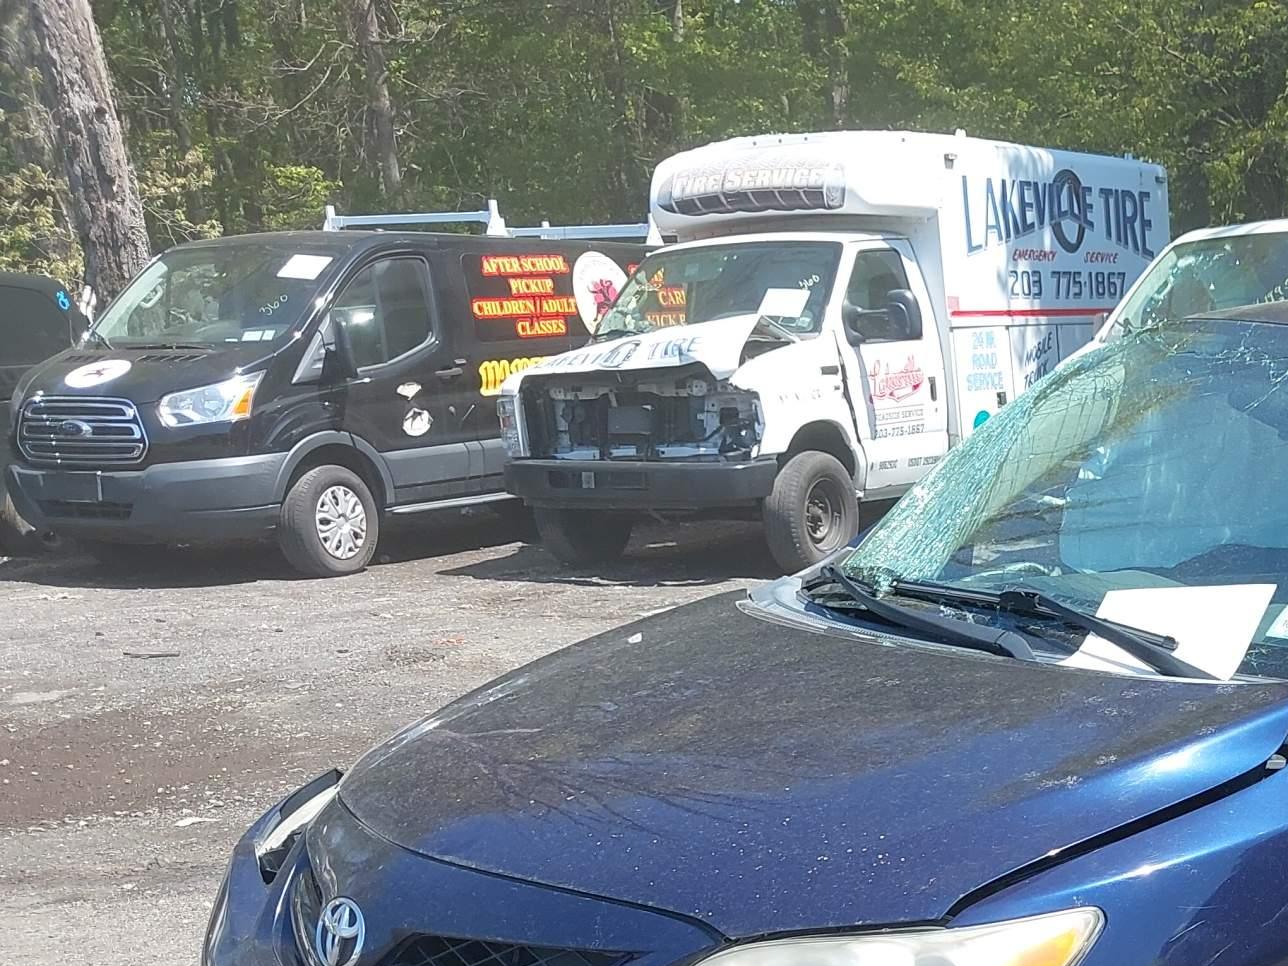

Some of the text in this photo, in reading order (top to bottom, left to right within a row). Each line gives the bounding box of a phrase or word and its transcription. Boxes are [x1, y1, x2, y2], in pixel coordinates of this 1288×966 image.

[724, 167, 824, 193] SERVICE
[961, 175, 1156, 263] LAKEVILLE TIRE
[481, 255, 522, 275] AFTER
[521, 254, 568, 273] SCHOOL
[1012, 248, 1119, 264] EMERGENCY SERVICE
[509, 277, 554, 295] PICKUP
[1009, 270, 1043, 300] 203
[473, 300, 535, 317] CHILDREN
[542, 298, 577, 315] ADULT
[516, 318, 566, 336] CLASSES
[648, 336, 703, 362] TIRE
[1023, 331, 1054, 366] MOBILE
[971, 352, 998, 370] ROAD
[966, 371, 1005, 391] SERVICE
[901, 408, 924, 420] SERVICE
